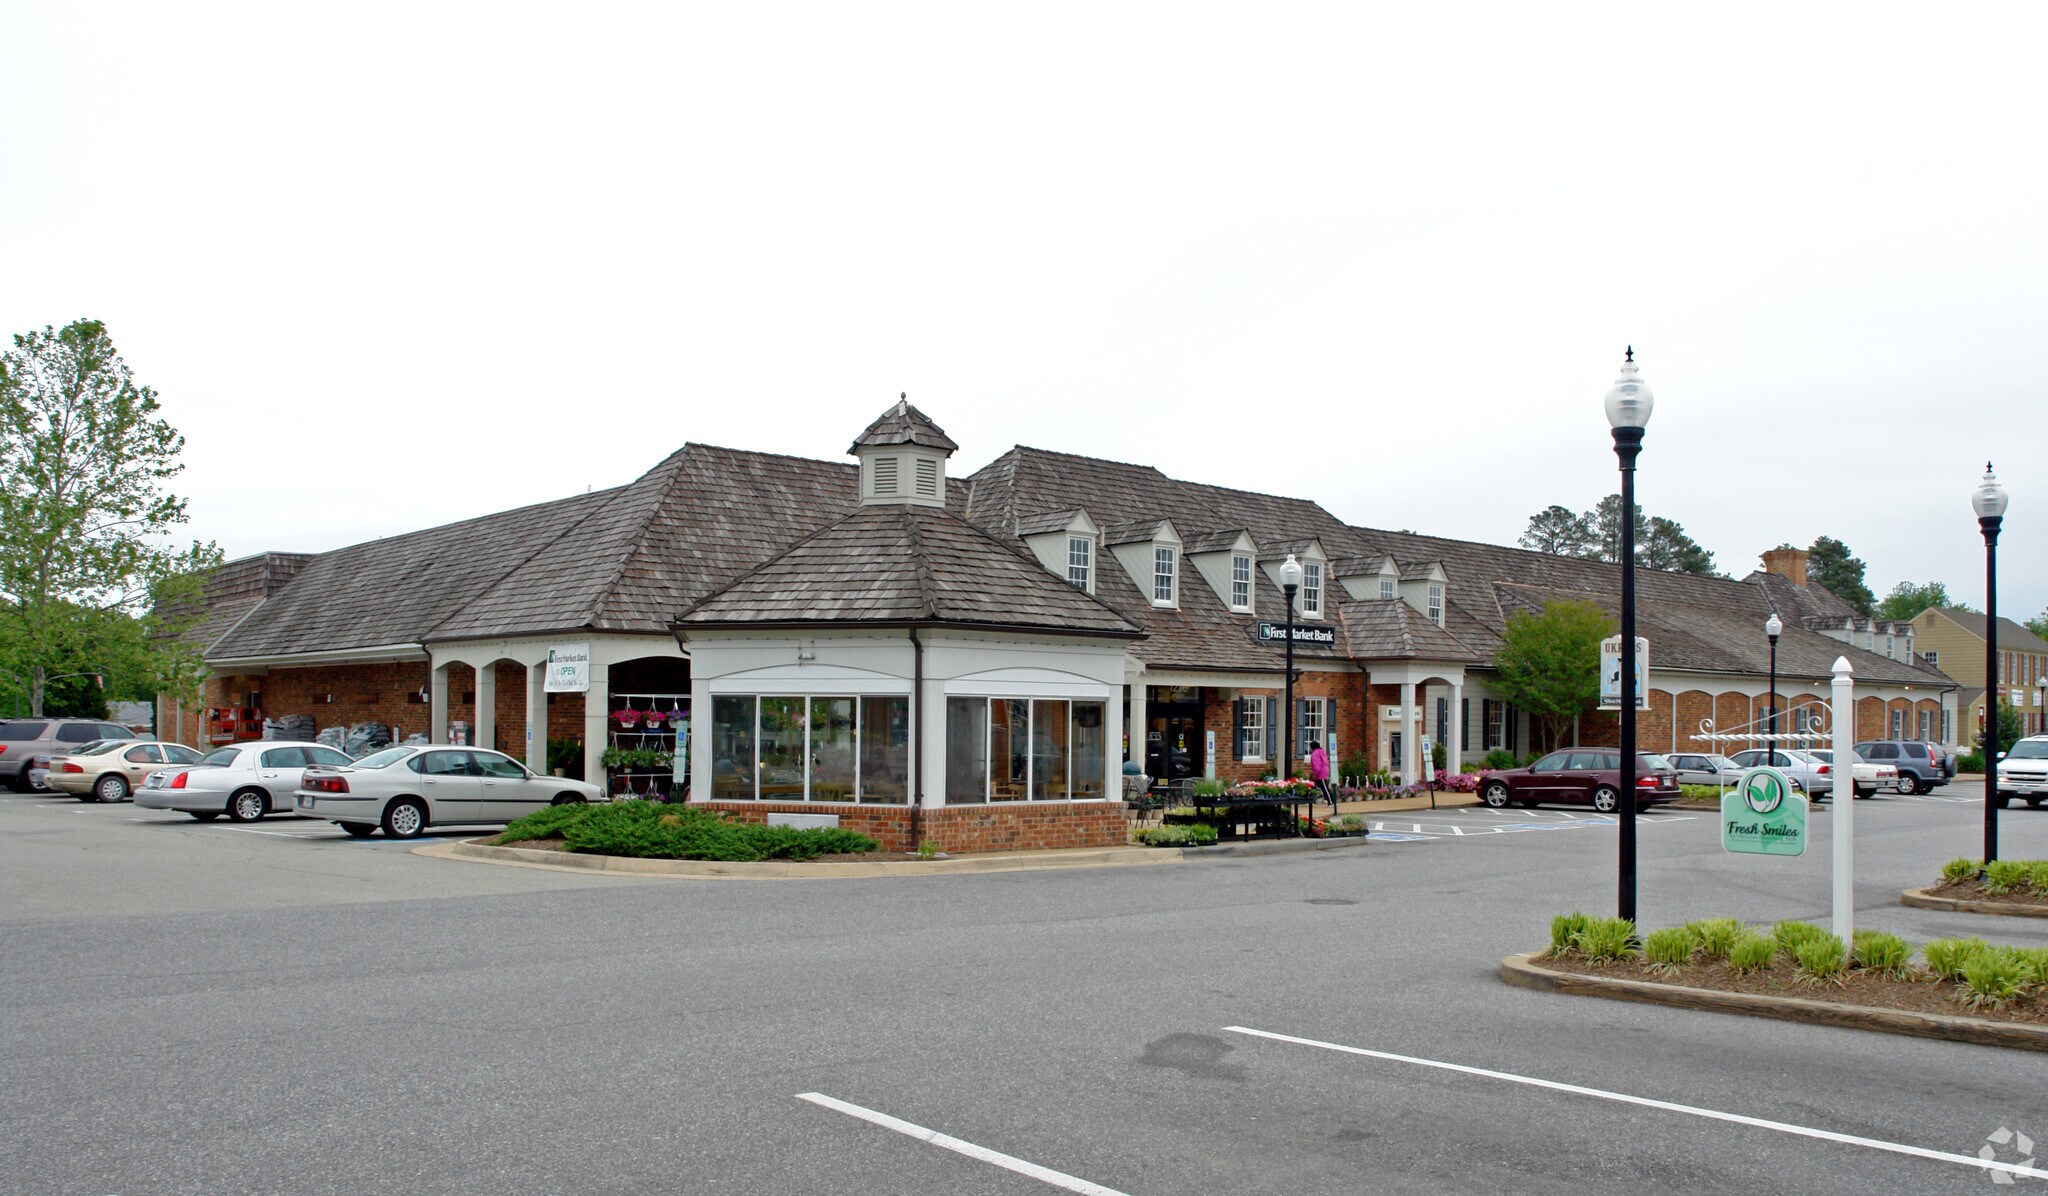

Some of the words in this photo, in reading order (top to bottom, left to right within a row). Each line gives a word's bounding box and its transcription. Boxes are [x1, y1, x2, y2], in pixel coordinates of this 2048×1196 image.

[1270, 627, 1287, 639] First
[1314, 630, 1333, 642] Bank
[561, 666, 575, 675] OPEN
[1727, 821, 1759, 835] Fresh
[1760, 823, 1799, 837] Smiles
